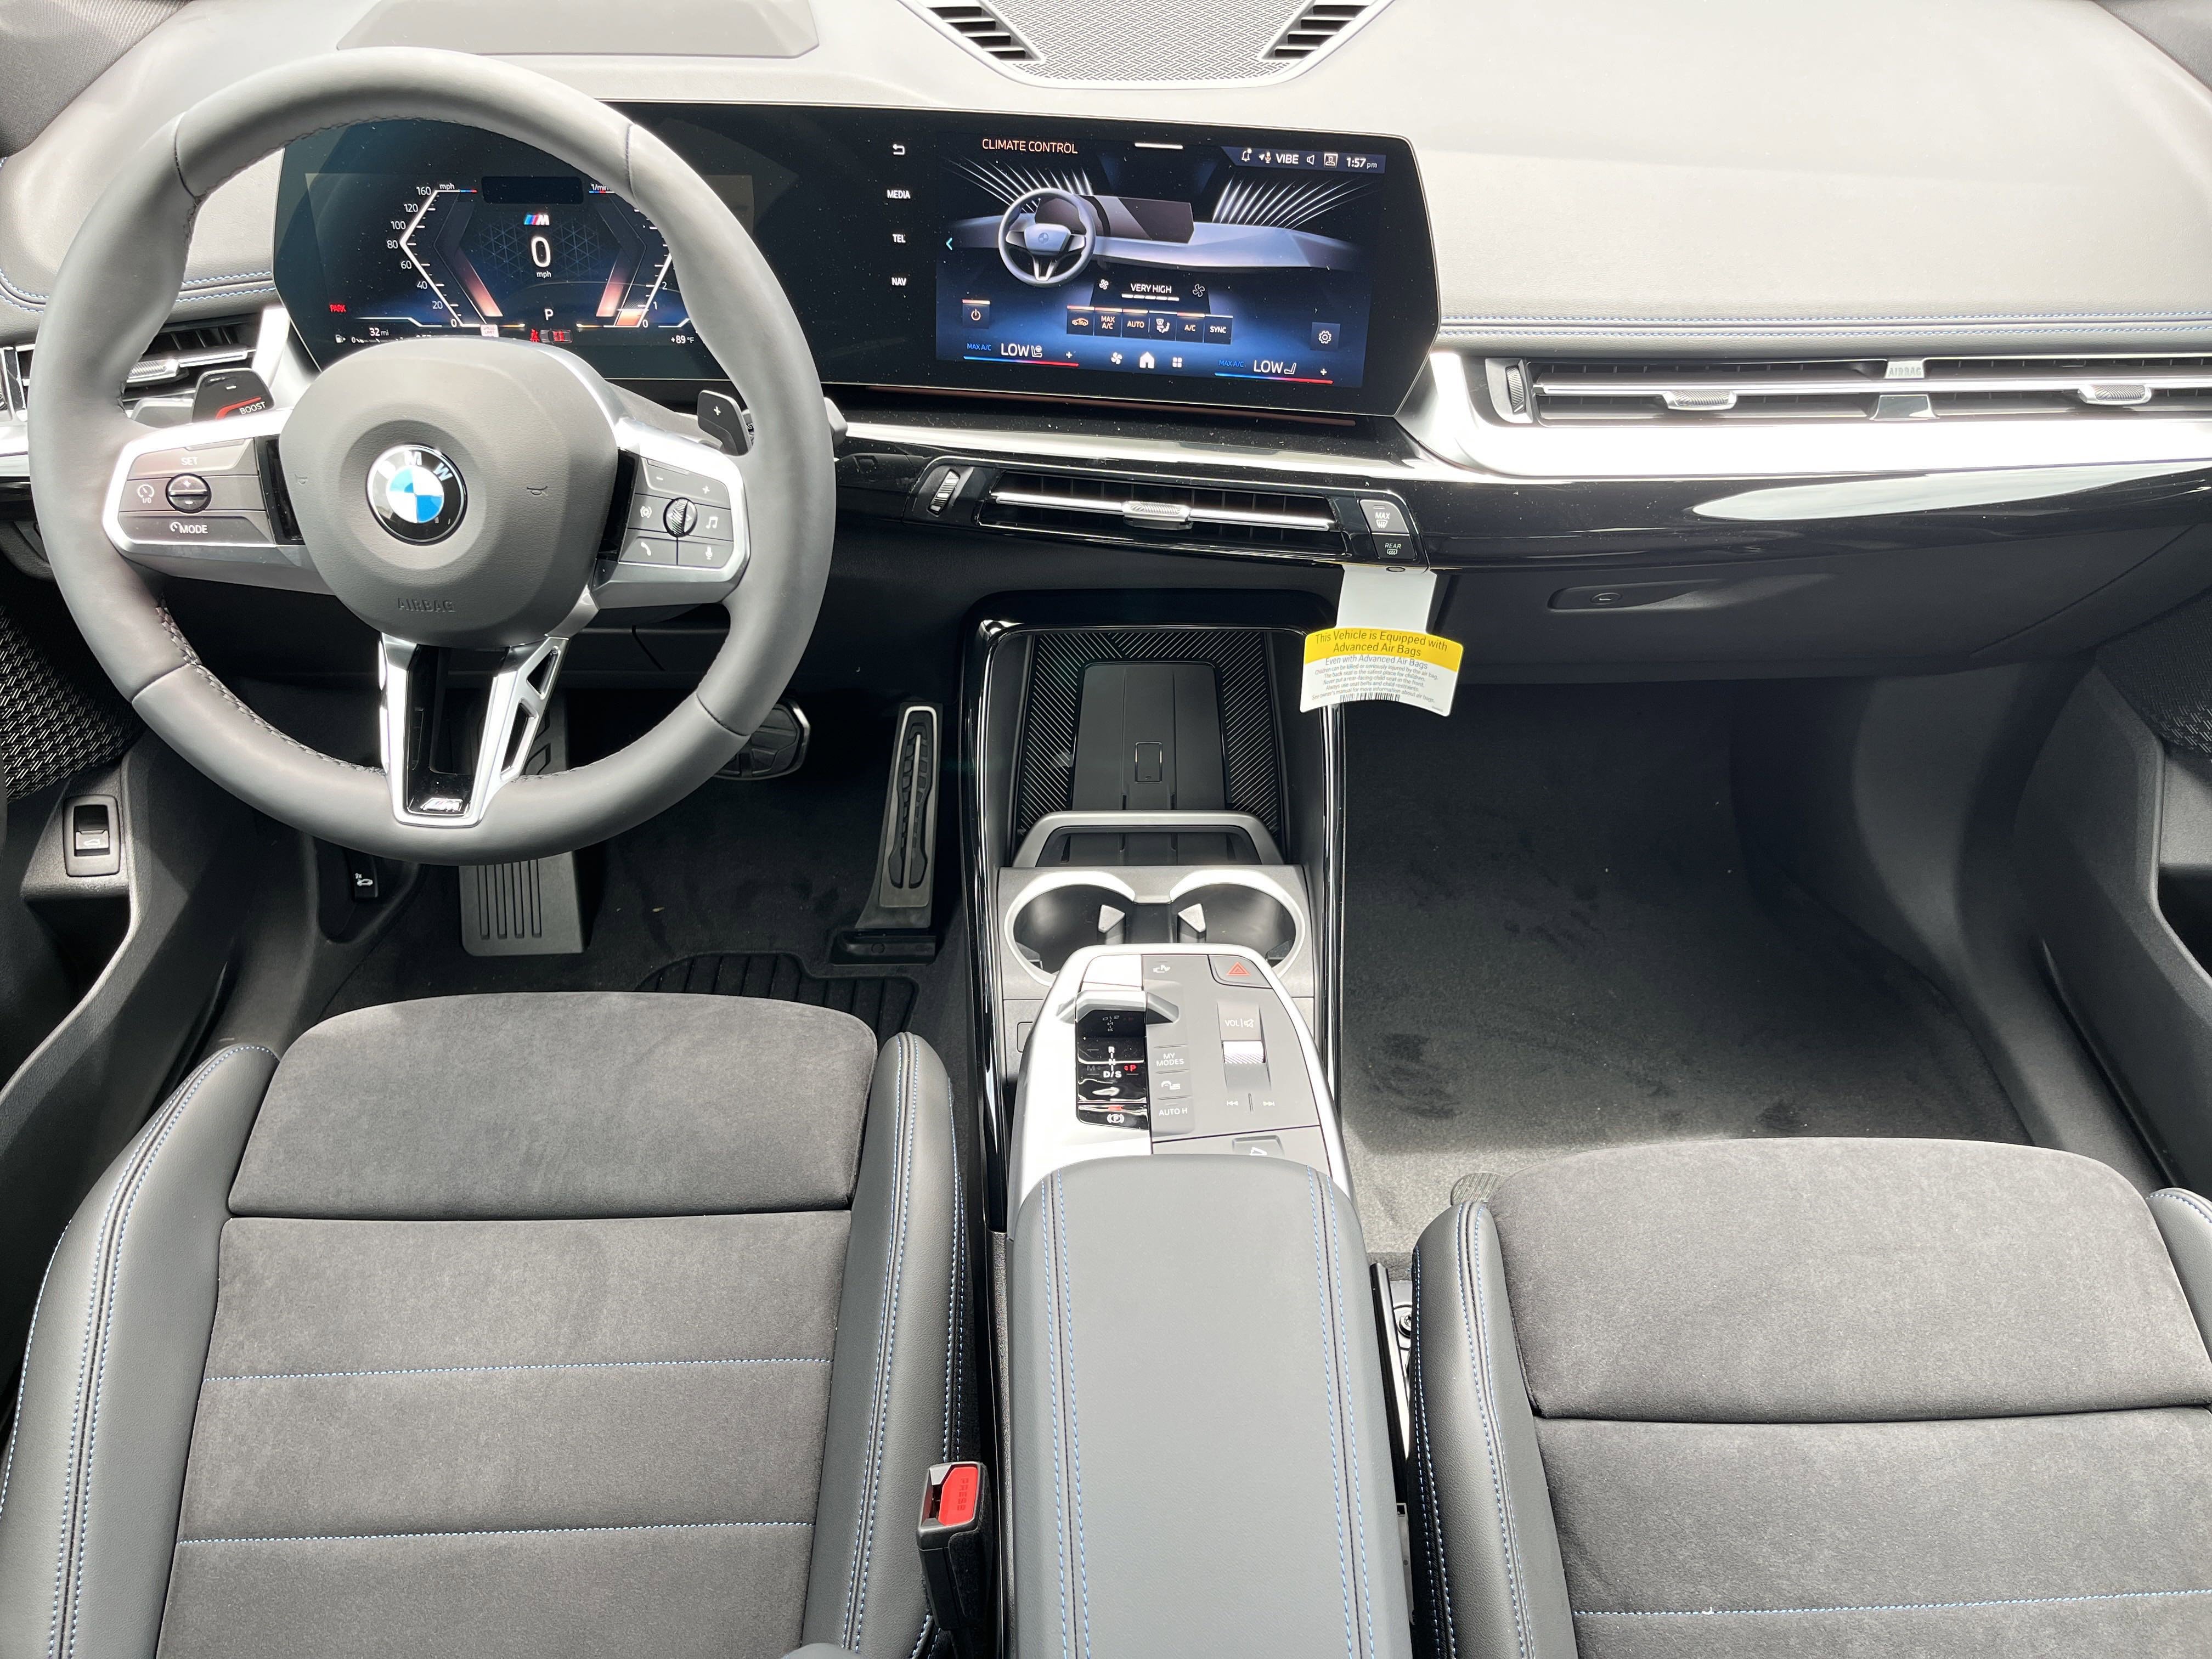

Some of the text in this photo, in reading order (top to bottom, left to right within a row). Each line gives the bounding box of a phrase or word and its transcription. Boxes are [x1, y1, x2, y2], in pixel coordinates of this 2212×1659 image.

[982, 138, 1078, 154] CLIMATE CONTROL
[1275, 153, 1299, 164] VIBE
[1346, 157, 1367, 168] 1:57
[416, 187, 431, 195] 160
[887, 189, 911, 199] MEDIA
[404, 204, 419, 213] 120
[391, 221, 406, 230] 100
[892, 234, 906, 243] TEL
[387, 240, 398, 249] 80
[531, 236, 551, 267] 0
[400, 260, 412, 269] 60
[537, 270, 551, 279] mph
[416, 281, 428, 290] 40
[662, 281, 668, 290] 2
[891, 277, 906, 286] NAV
[1130, 283, 1172, 294] VERY HIGH
[330, 304, 347, 313] PARK
[432, 301, 443, 309] 20
[653, 301, 658, 310] 1
[544, 309, 554, 321] P
[1101, 315, 1115, 324] MAX
[450, 319, 457, 328] 0
[642, 319, 648, 328] 0
[369, 328, 381, 337] 32
[1210, 326, 1227, 334] SYNC
[671, 335, 686, 344] +89
[1001, 343, 1030, 357] LOW
[1254, 360, 1284, 374] LOW
[1888, 366, 1922, 377] AIRBAG
[239, 401, 266, 415] BOOST
[180, 456, 198, 466] SET
[1375, 512, 1390, 520] MAX
[179, 524, 208, 534] MODE
[398, 597, 456, 612] AIRBAG
[1316, 630, 1448, 652] This Vehicle is Equipped with
[1333, 642, 1421, 657] Advanced Air Bags
[1325, 657, 1341, 666] Even
[1358, 654, 1396, 664] Advanced
[1409, 658, 1428, 670] Bags
[1315, 667, 1331, 675] Children
[1159, 1109, 1180, 1117] AUTO
